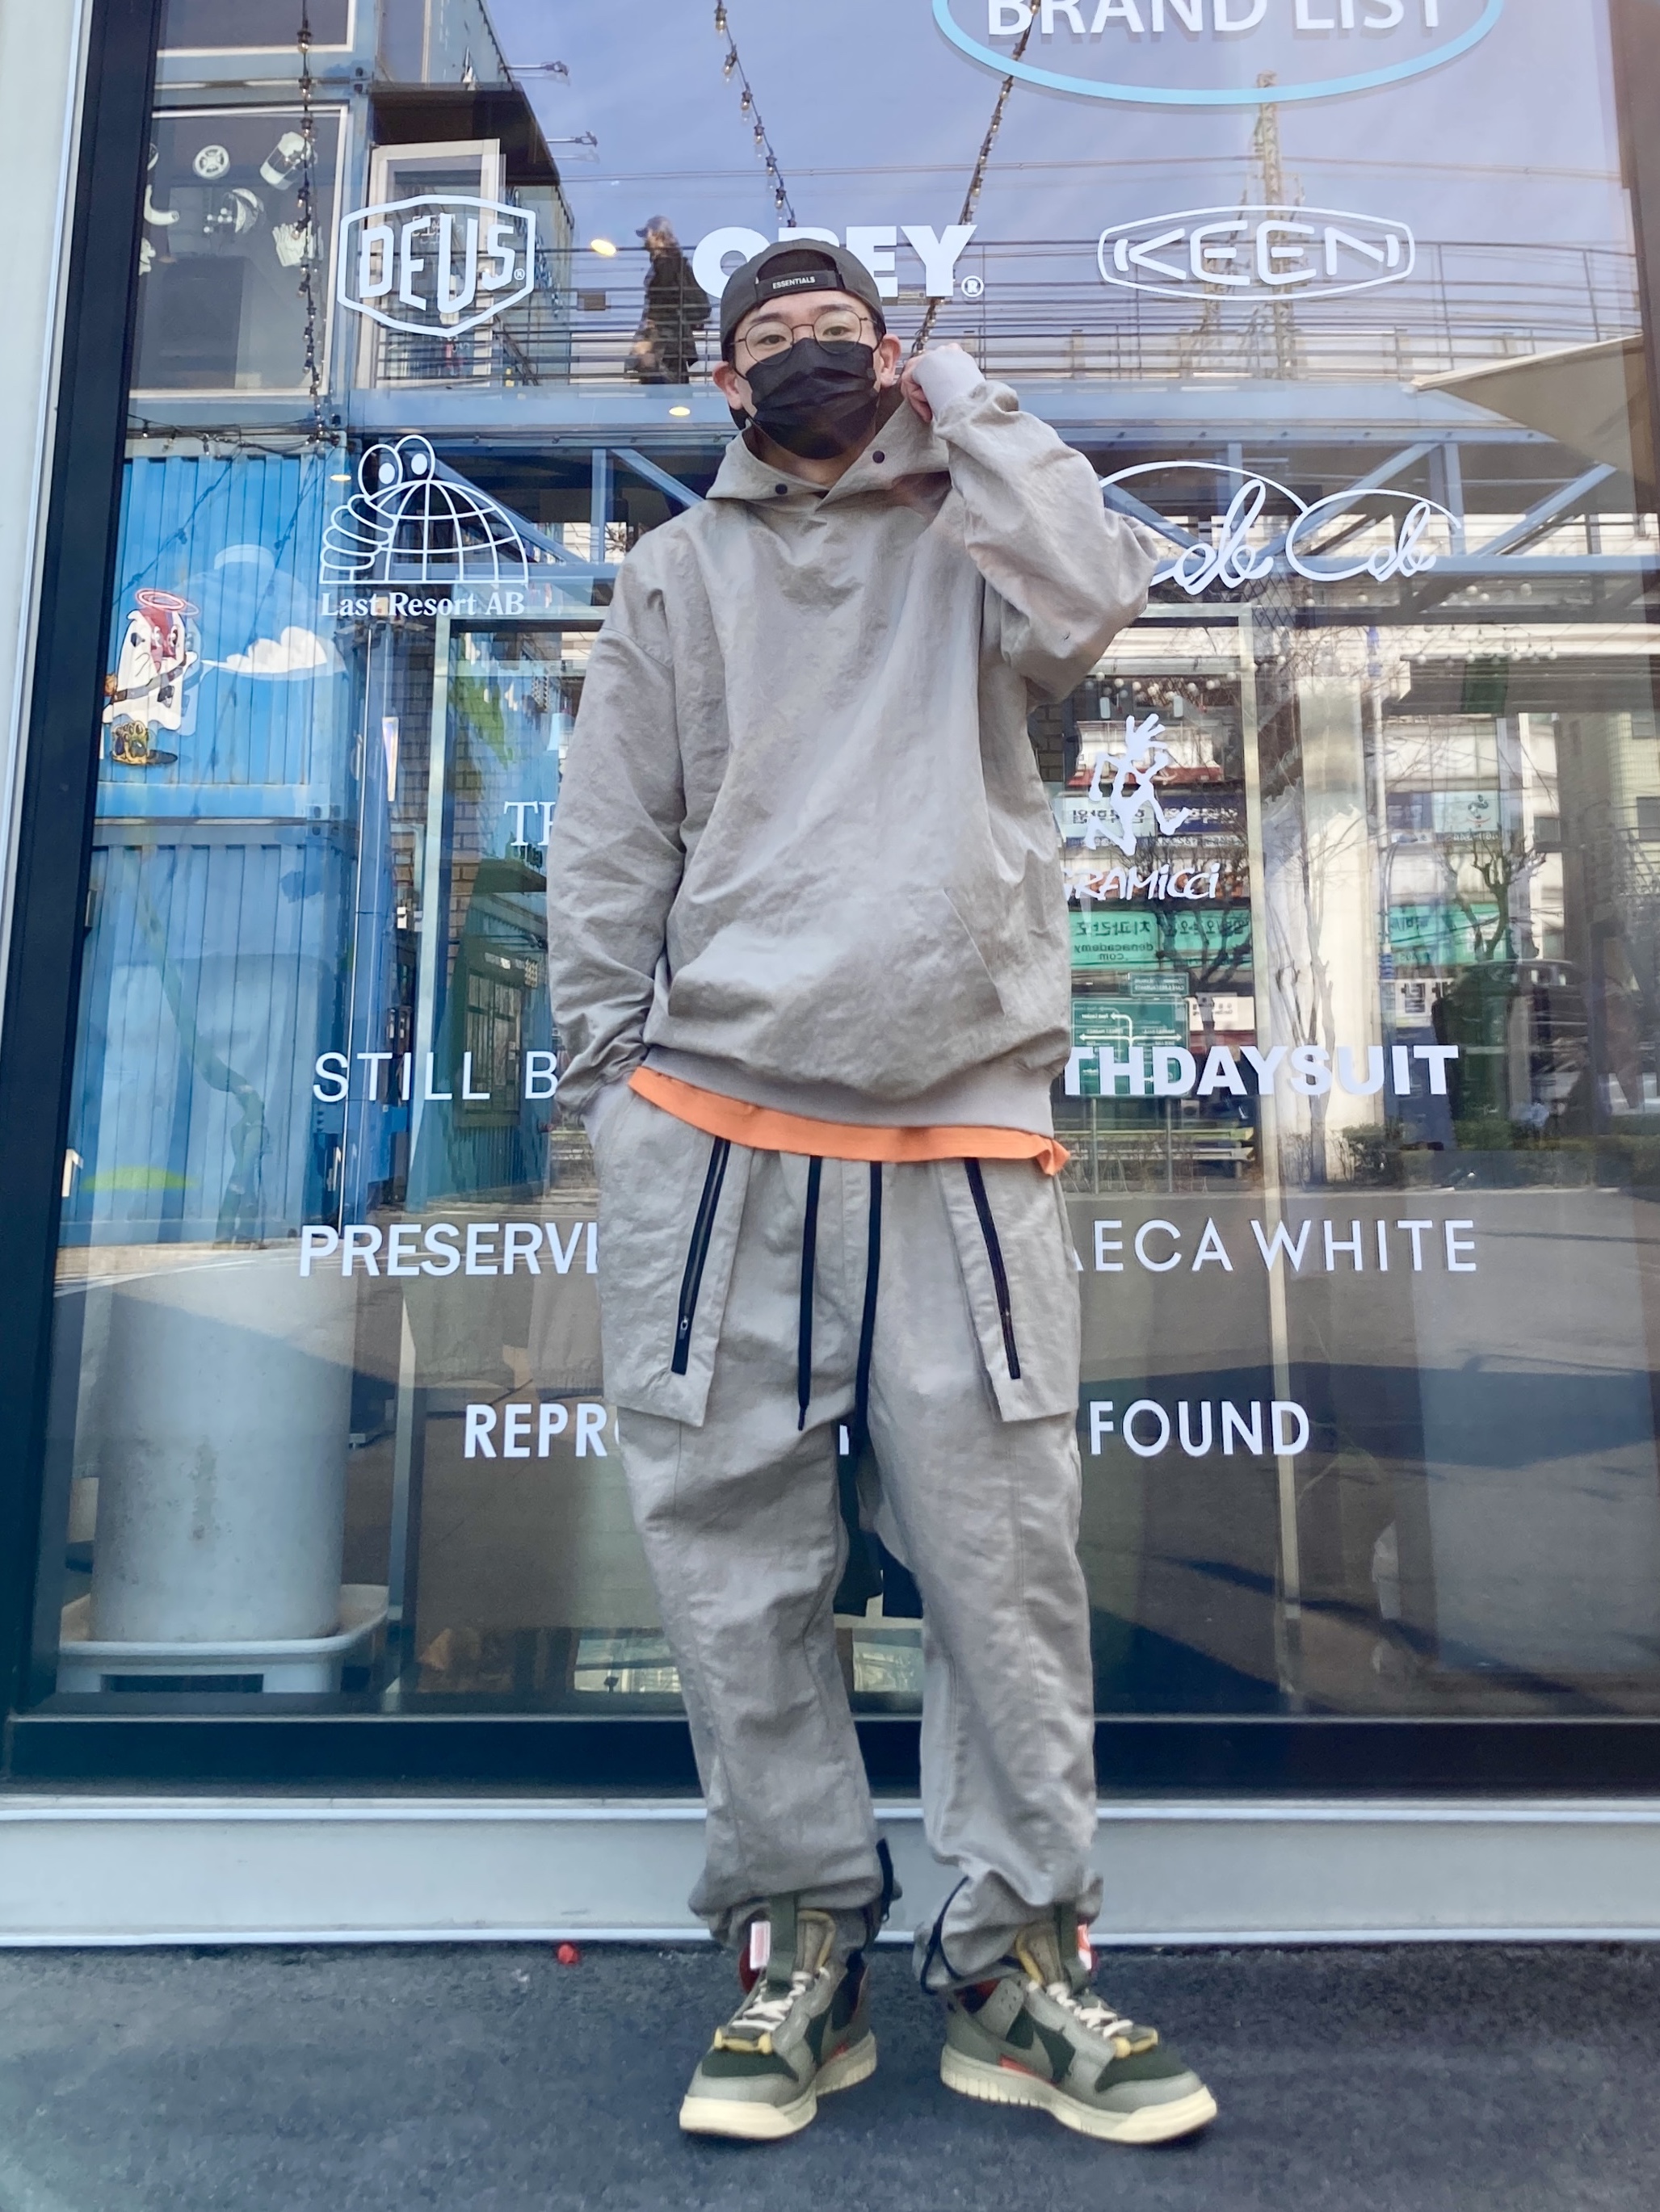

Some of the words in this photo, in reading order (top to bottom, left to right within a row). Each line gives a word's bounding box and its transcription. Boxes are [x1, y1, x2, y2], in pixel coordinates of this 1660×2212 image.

[1128, 220, 1385, 286] KEEN
[772, 276, 816, 289] ESSENTIALS
[321, 593, 379, 616] Last
[389, 592, 476, 616] Resort
[485, 592, 524, 615] AB
[313, 1052, 490, 1102] STILL
[1074, 1217, 1233, 1271] ECA
[1250, 1219, 1477, 1272] WHITE
[464, 1404, 620, 1458] REPR
[1091, 1400, 1309, 1456] FOUND
